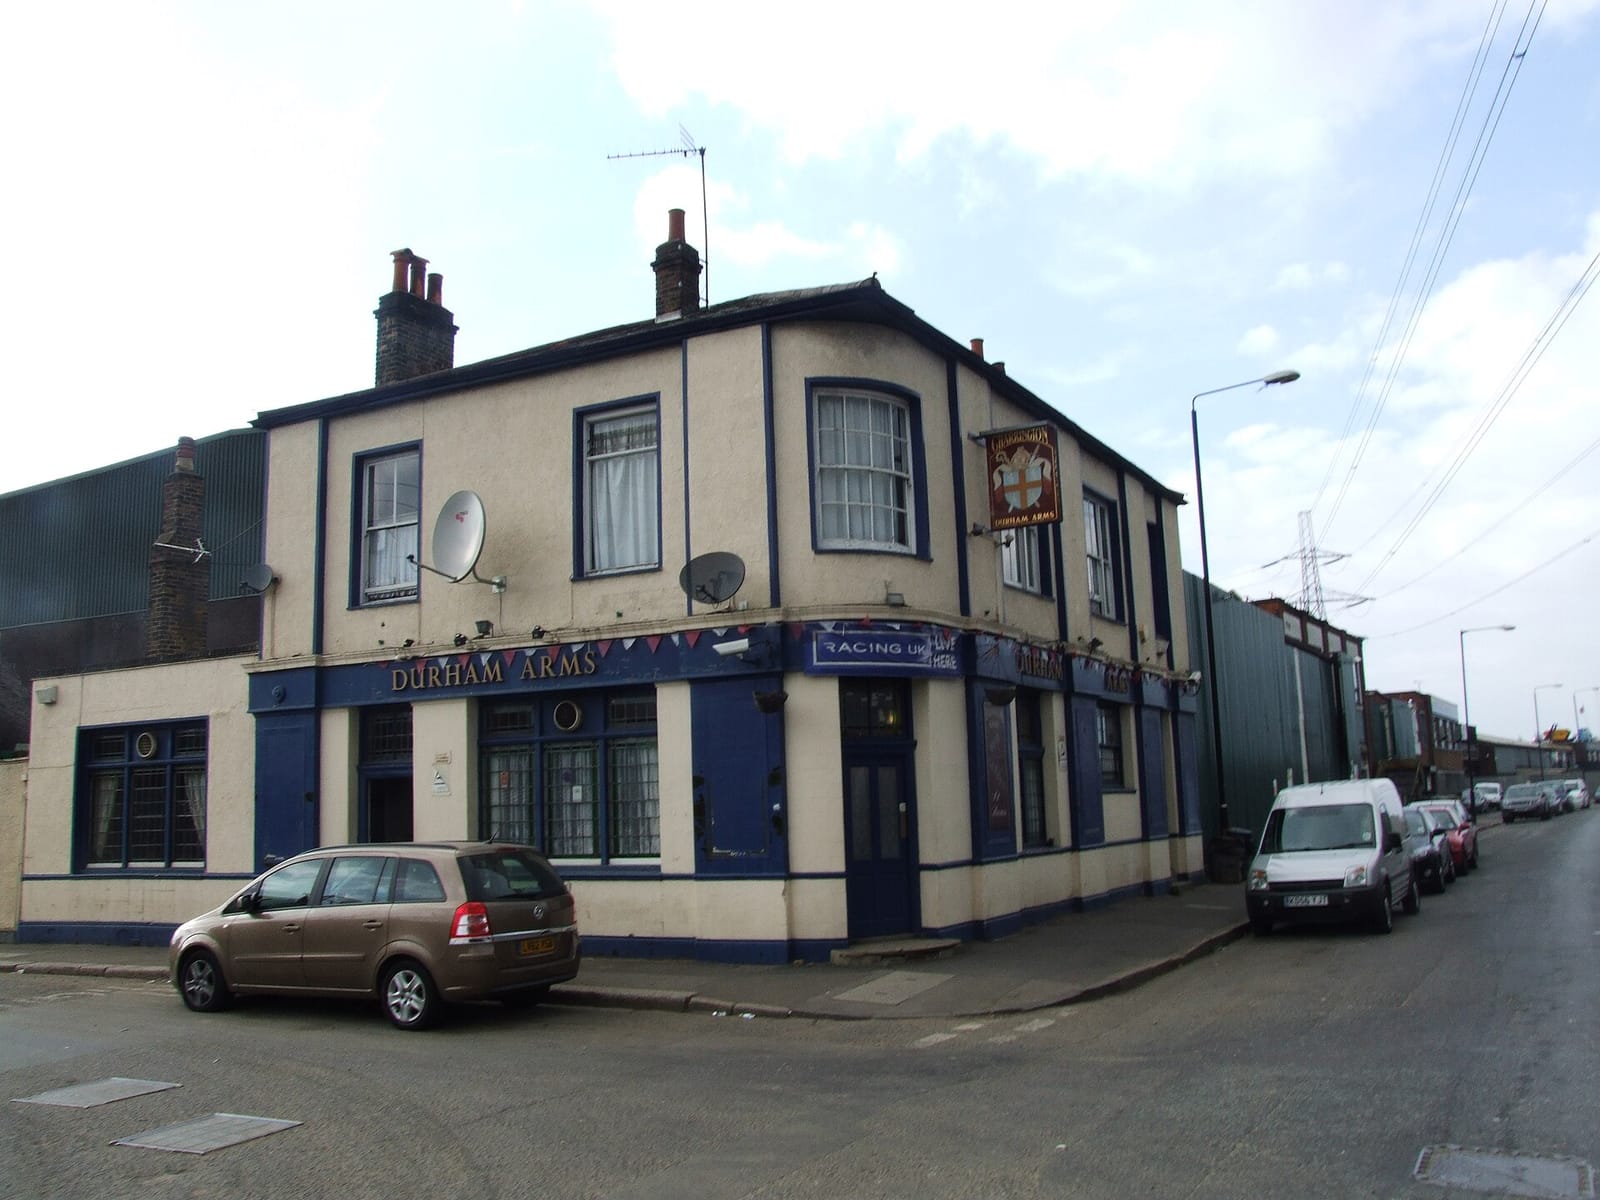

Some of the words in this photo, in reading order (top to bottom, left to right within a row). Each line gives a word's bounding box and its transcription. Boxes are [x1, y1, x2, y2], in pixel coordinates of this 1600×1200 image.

[995, 515, 1029, 528] DURHAM
[1032, 511, 1055, 522] ARMS
[823, 641, 902, 655] RACING
[907, 643, 926, 656] UK
[932, 654, 958, 670] HERE
[391, 659, 504, 691] DURHAM
[520, 650, 598, 680] ARMS
